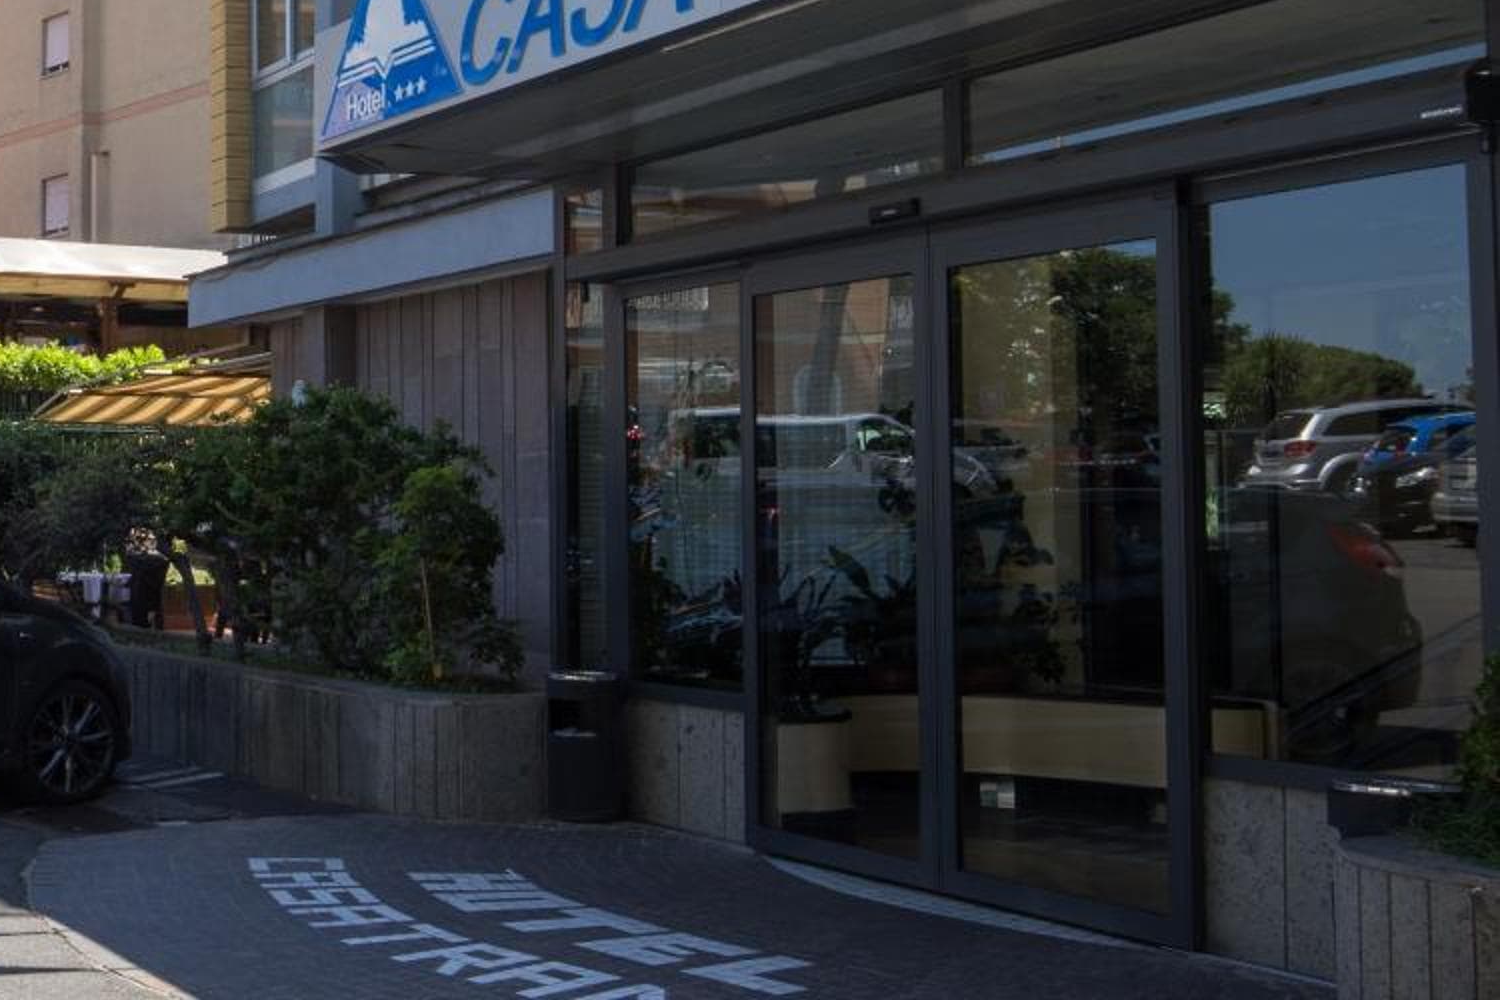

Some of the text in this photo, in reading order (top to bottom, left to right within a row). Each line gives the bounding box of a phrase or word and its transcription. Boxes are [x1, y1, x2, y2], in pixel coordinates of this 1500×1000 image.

[346, 88, 387, 121] Hotel
[248, 857, 623, 999] CASA TRA
[406, 867, 814, 996] HOTEL
